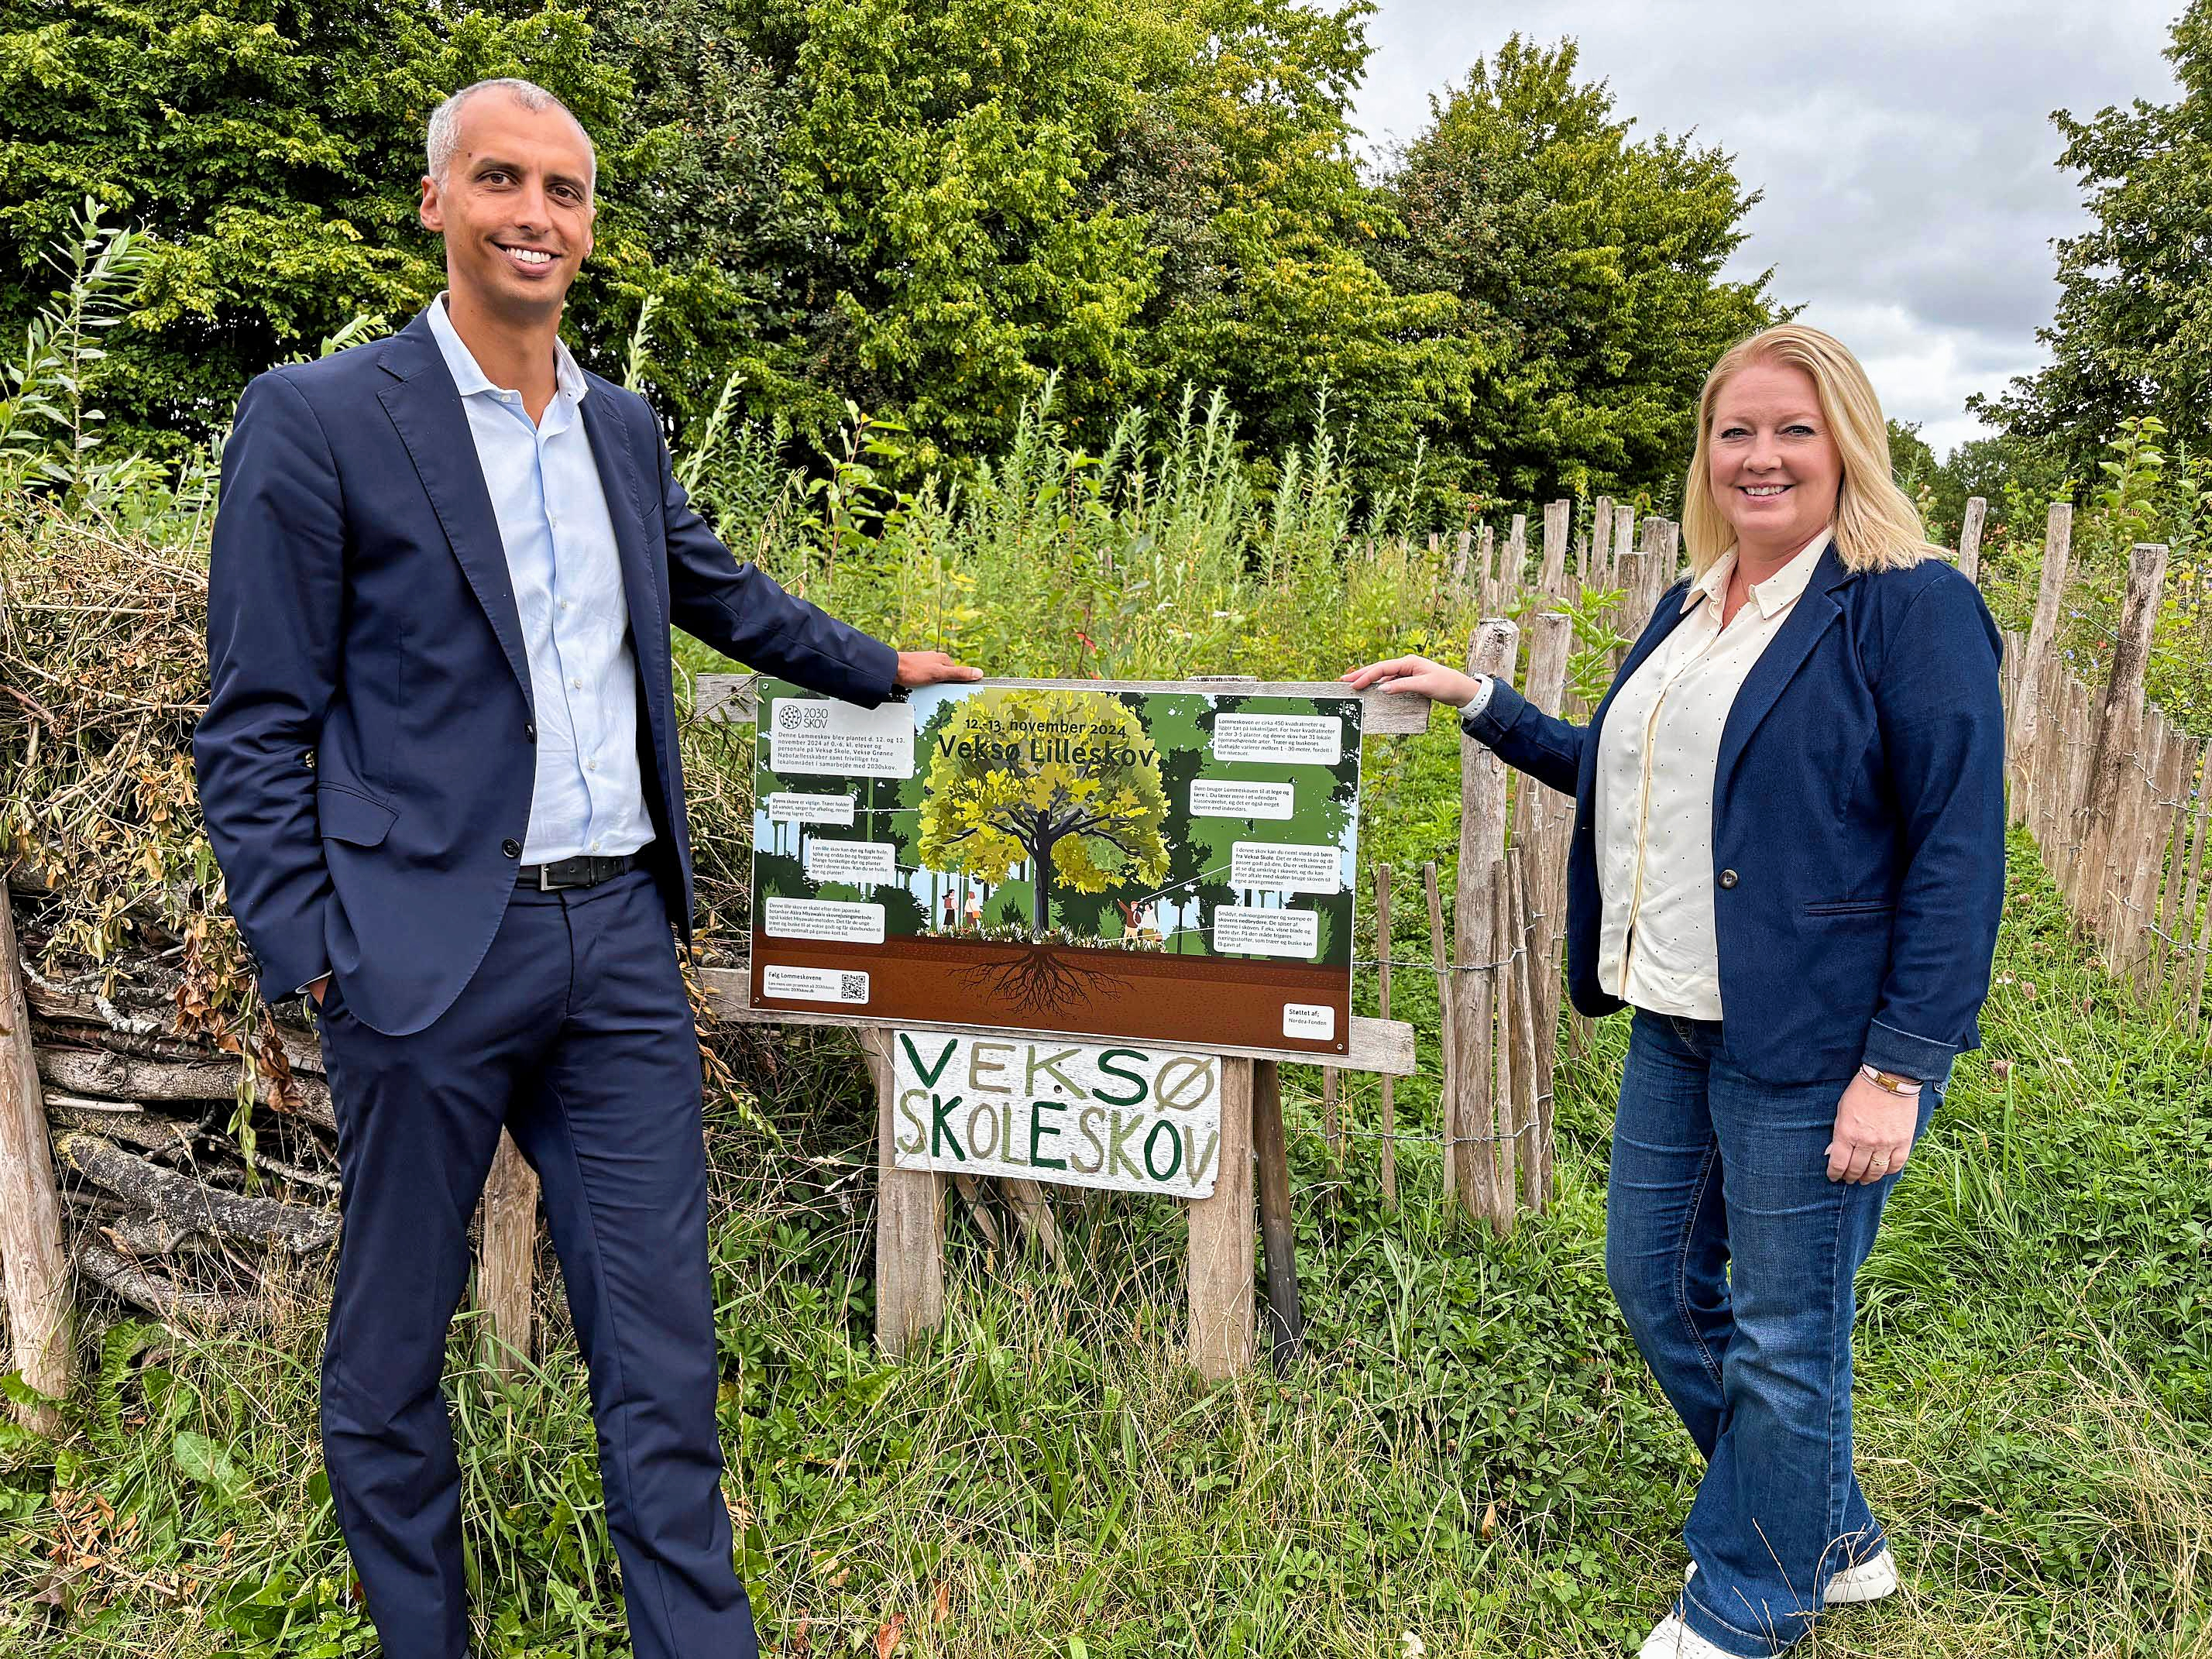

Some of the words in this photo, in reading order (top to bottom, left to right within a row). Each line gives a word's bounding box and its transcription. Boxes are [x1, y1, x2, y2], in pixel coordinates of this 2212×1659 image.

[804, 708, 828, 718] 2030
[804, 719, 828, 728] SKOV
[965, 718, 1005, 732] 12.-13.
[1010, 720, 1085, 733] november
[1091, 723, 1126, 737] 2024
[937, 734, 1020, 761] Veksø
[1030, 738, 1155, 767] Lilleskov
[899, 1032, 1214, 1113] VEKSØ
[896, 1088, 1219, 1187] SKOLESKOV
